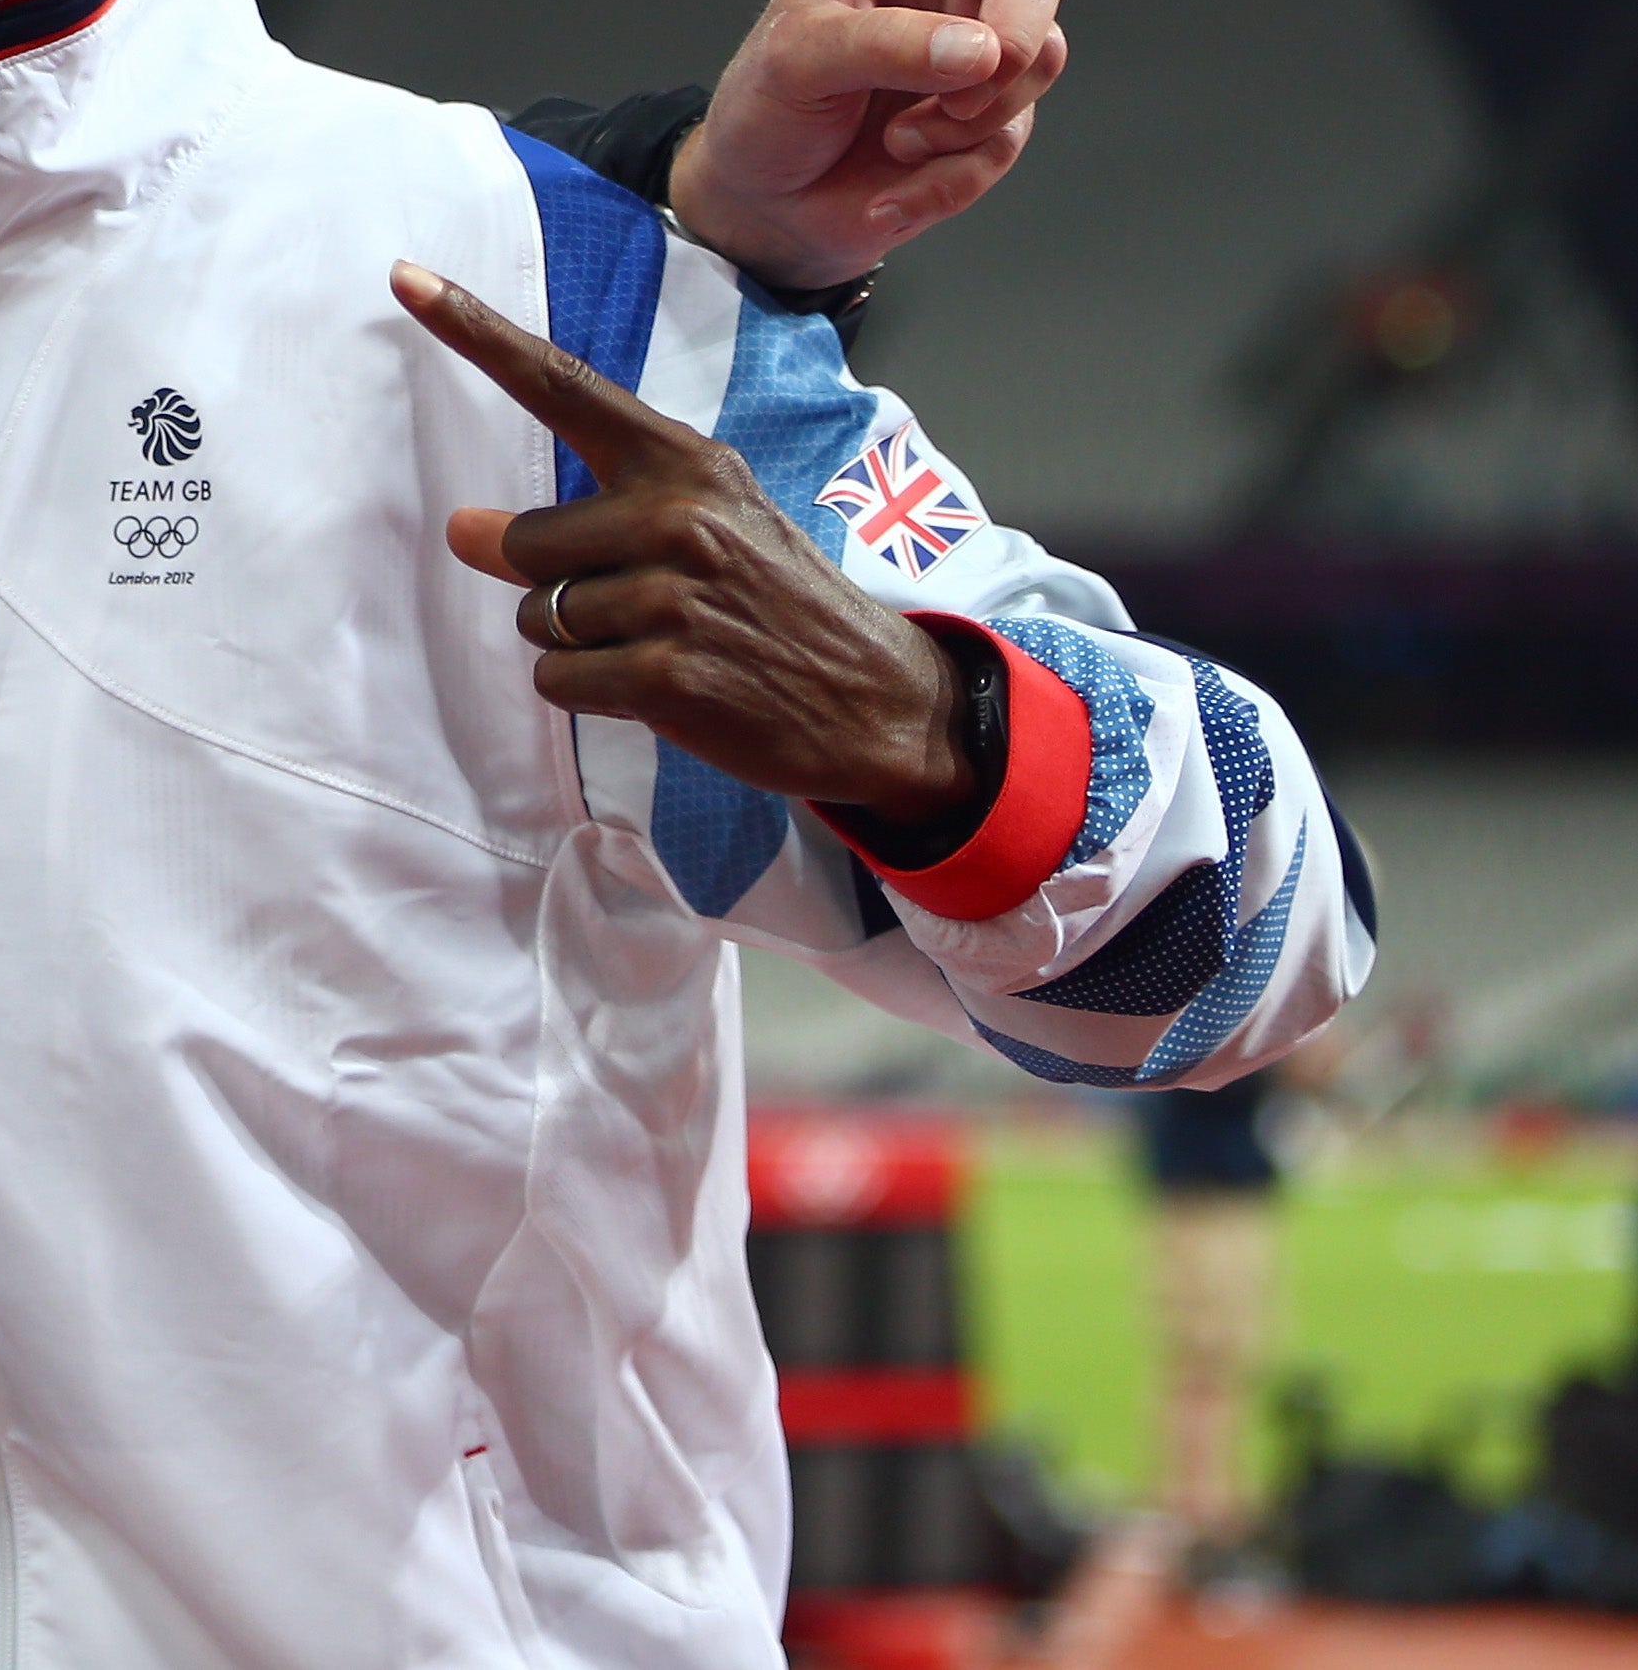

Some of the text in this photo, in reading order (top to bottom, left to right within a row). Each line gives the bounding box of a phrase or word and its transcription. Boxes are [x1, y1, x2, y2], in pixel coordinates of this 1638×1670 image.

[109, 479, 212, 502] TEAM GB
[108, 571, 195, 585] London 2012
